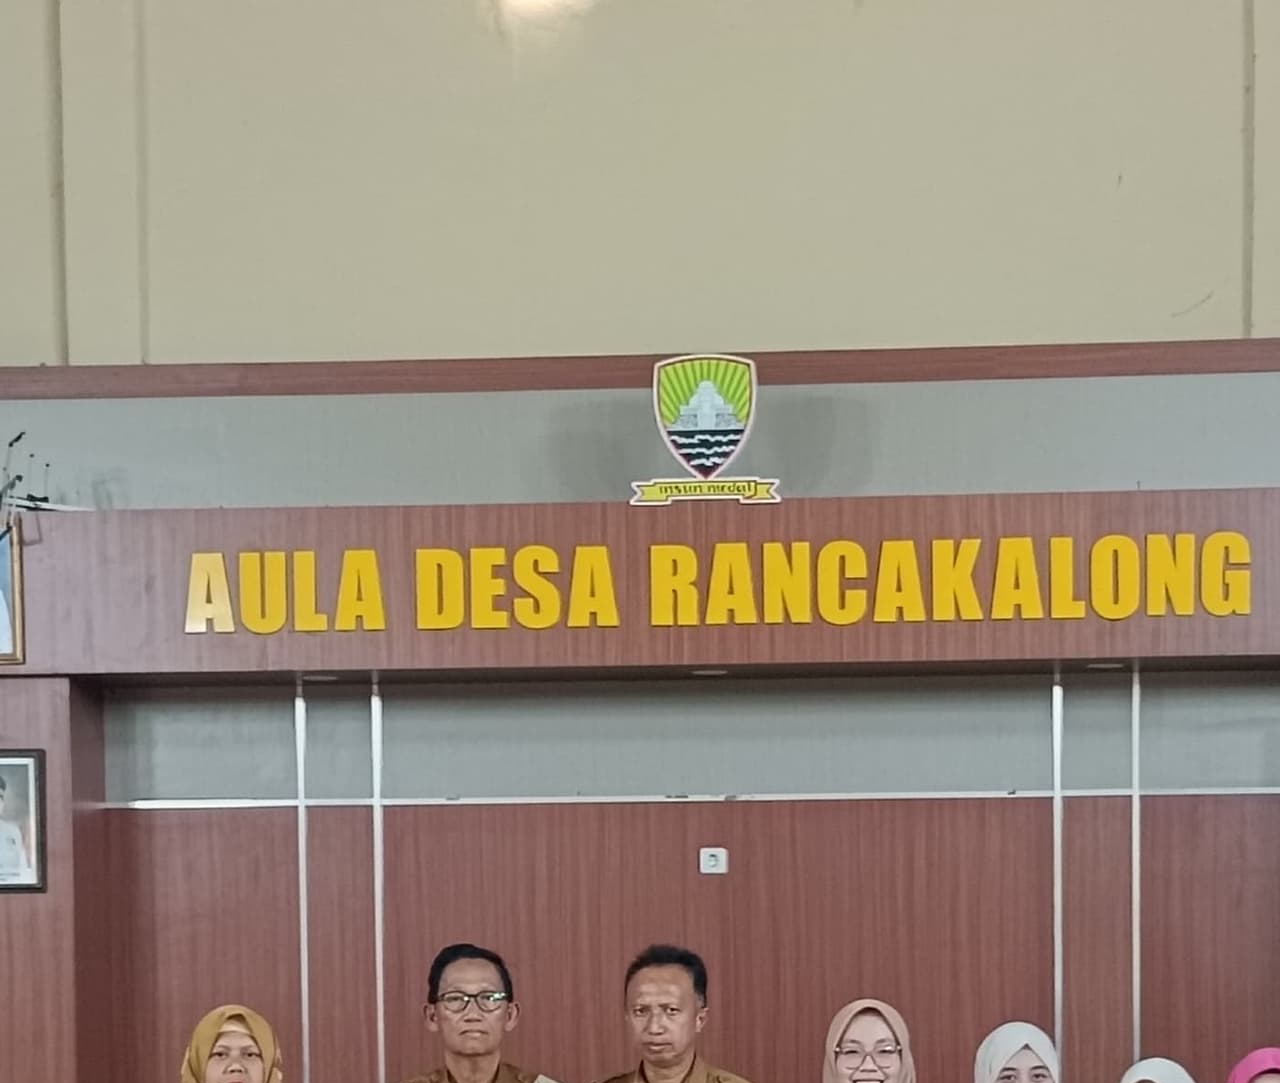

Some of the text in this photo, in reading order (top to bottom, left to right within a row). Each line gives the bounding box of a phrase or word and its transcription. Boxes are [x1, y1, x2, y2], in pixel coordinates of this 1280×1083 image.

[184, 531, 1253, 634] AULA DESA RANCAKALONG
